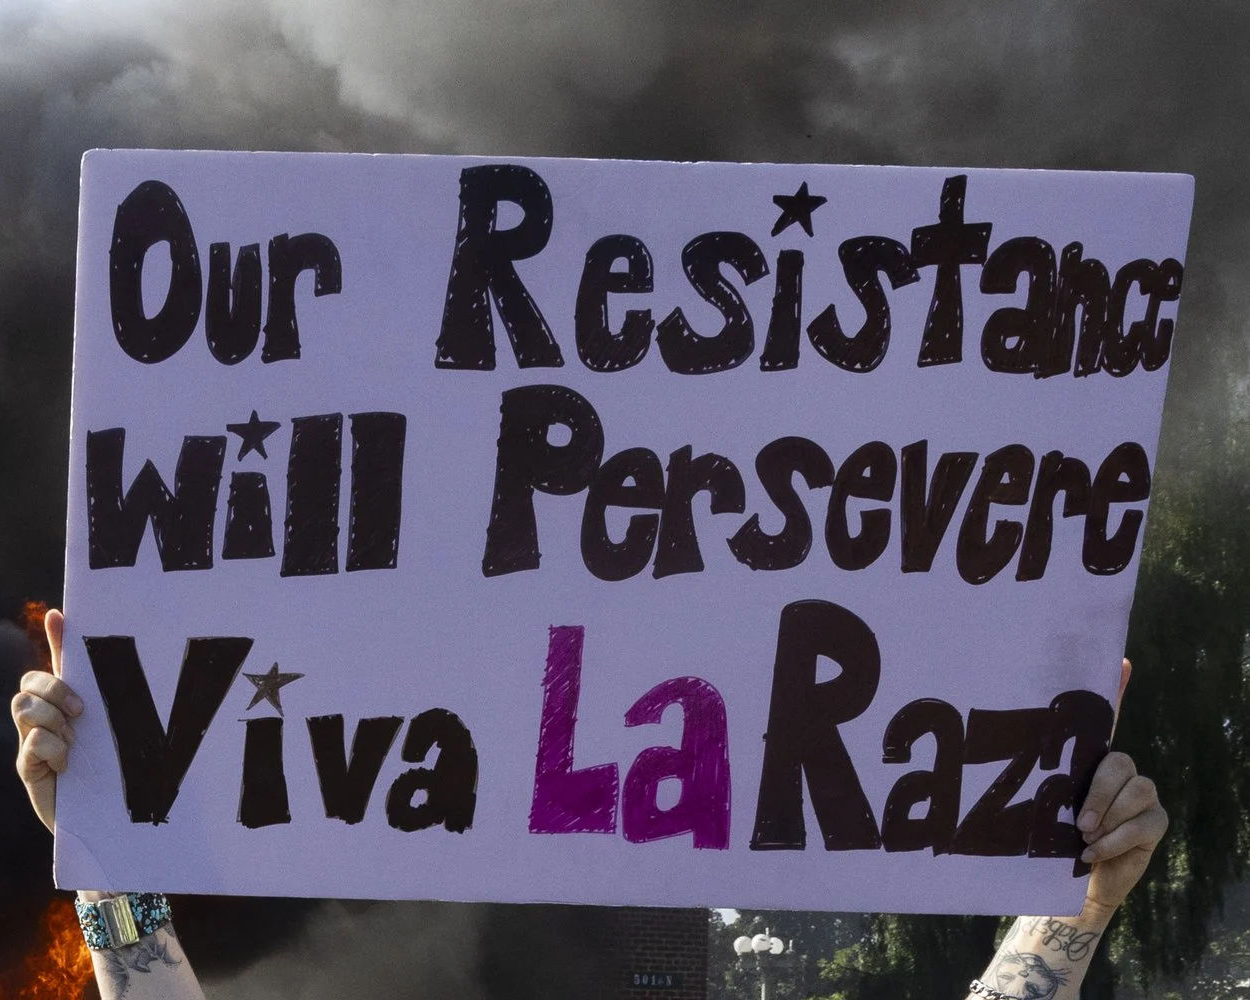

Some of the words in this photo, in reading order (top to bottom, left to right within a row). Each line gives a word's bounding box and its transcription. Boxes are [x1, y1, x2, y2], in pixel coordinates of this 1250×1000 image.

[109, 180, 342, 366] Our
[435, 164, 1185, 378] Resistance
[482, 384, 1150, 585] Persevere
[82, 636, 479, 834] Viva
[528, 626, 731, 850] La
[750, 599, 1116, 877] Raza
